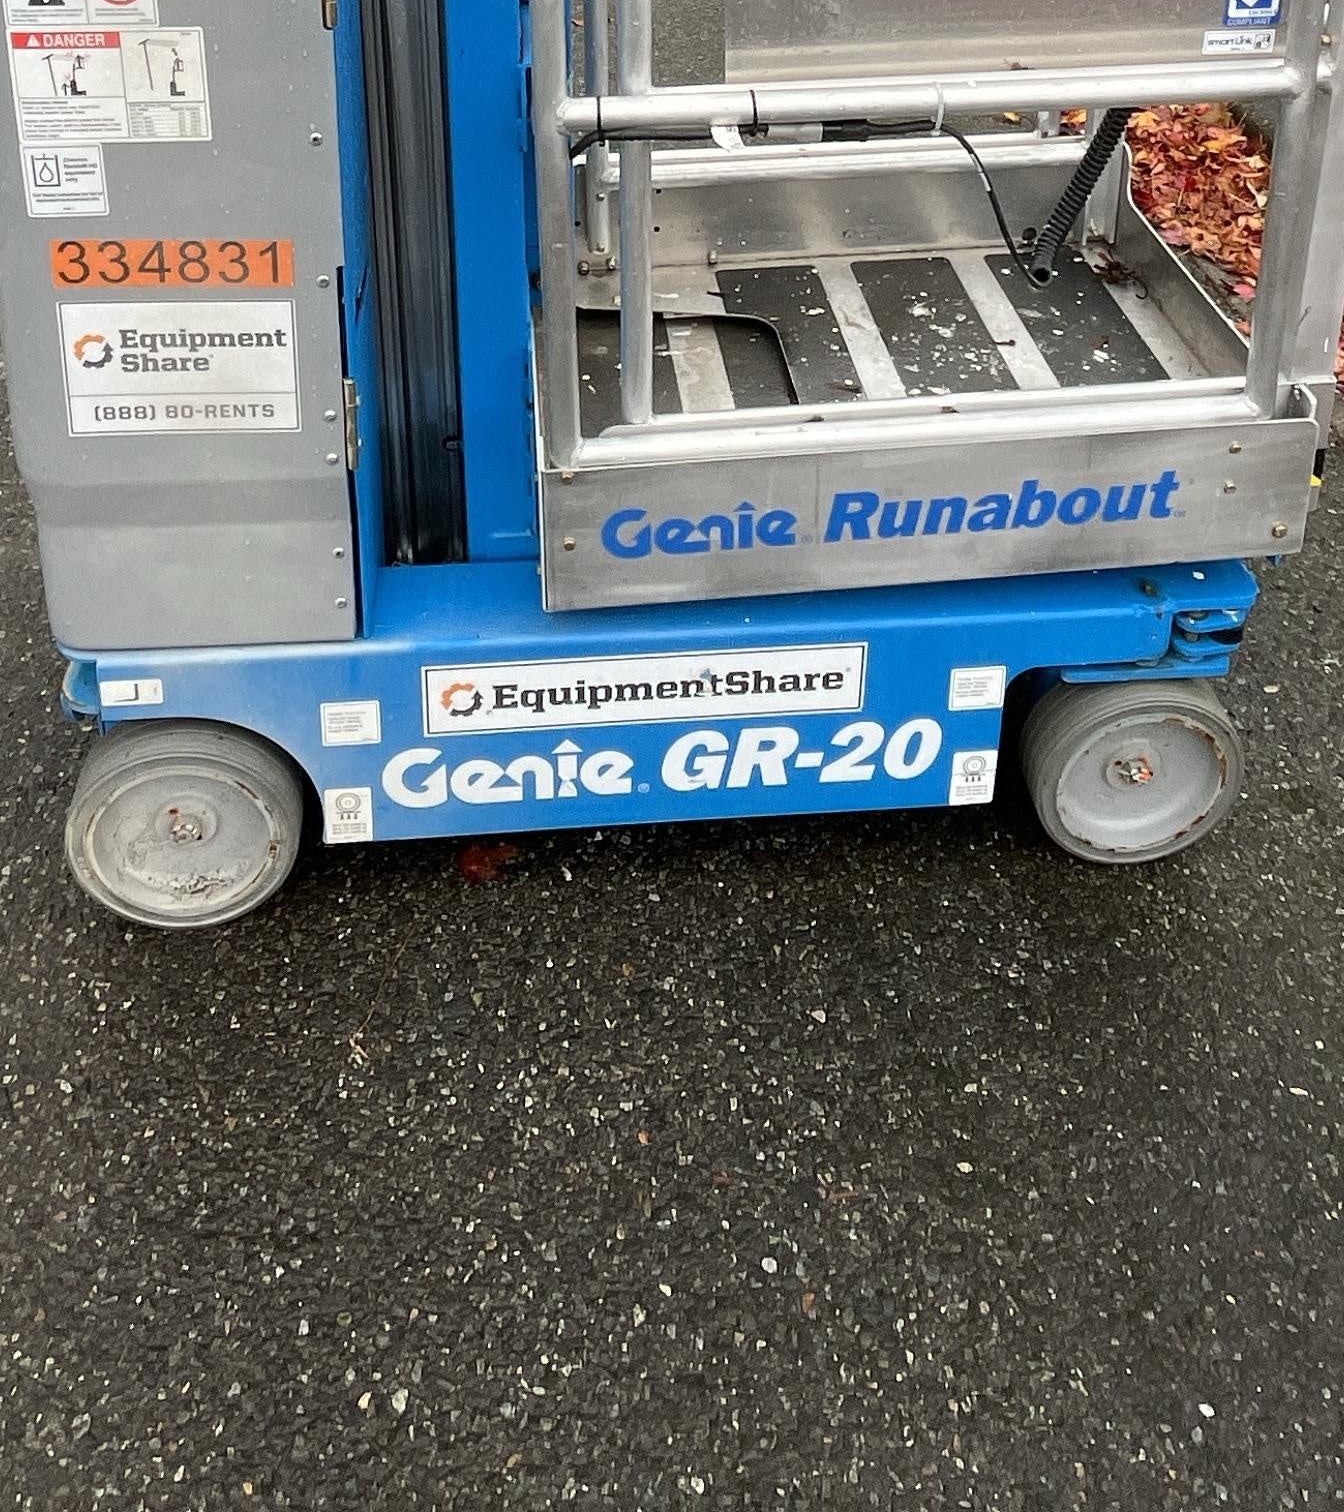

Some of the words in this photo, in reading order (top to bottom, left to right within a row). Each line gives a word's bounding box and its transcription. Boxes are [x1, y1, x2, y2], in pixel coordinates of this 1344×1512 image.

[42, 33, 106, 48] DANGER
[57, 241, 280, 284] 334831
[119, 329, 288, 353] Equipment
[120, 353, 211, 373] Share
[94, 404, 156, 422] (888)
[165, 403, 276, 419] 80-RENTS
[601, 501, 798, 560] Genie
[822, 470, 1181, 543] Runabout
[492, 668, 845, 713] EquipmentShare
[381, 738, 635, 809] Genie
[661, 718, 943, 792] GR-20
